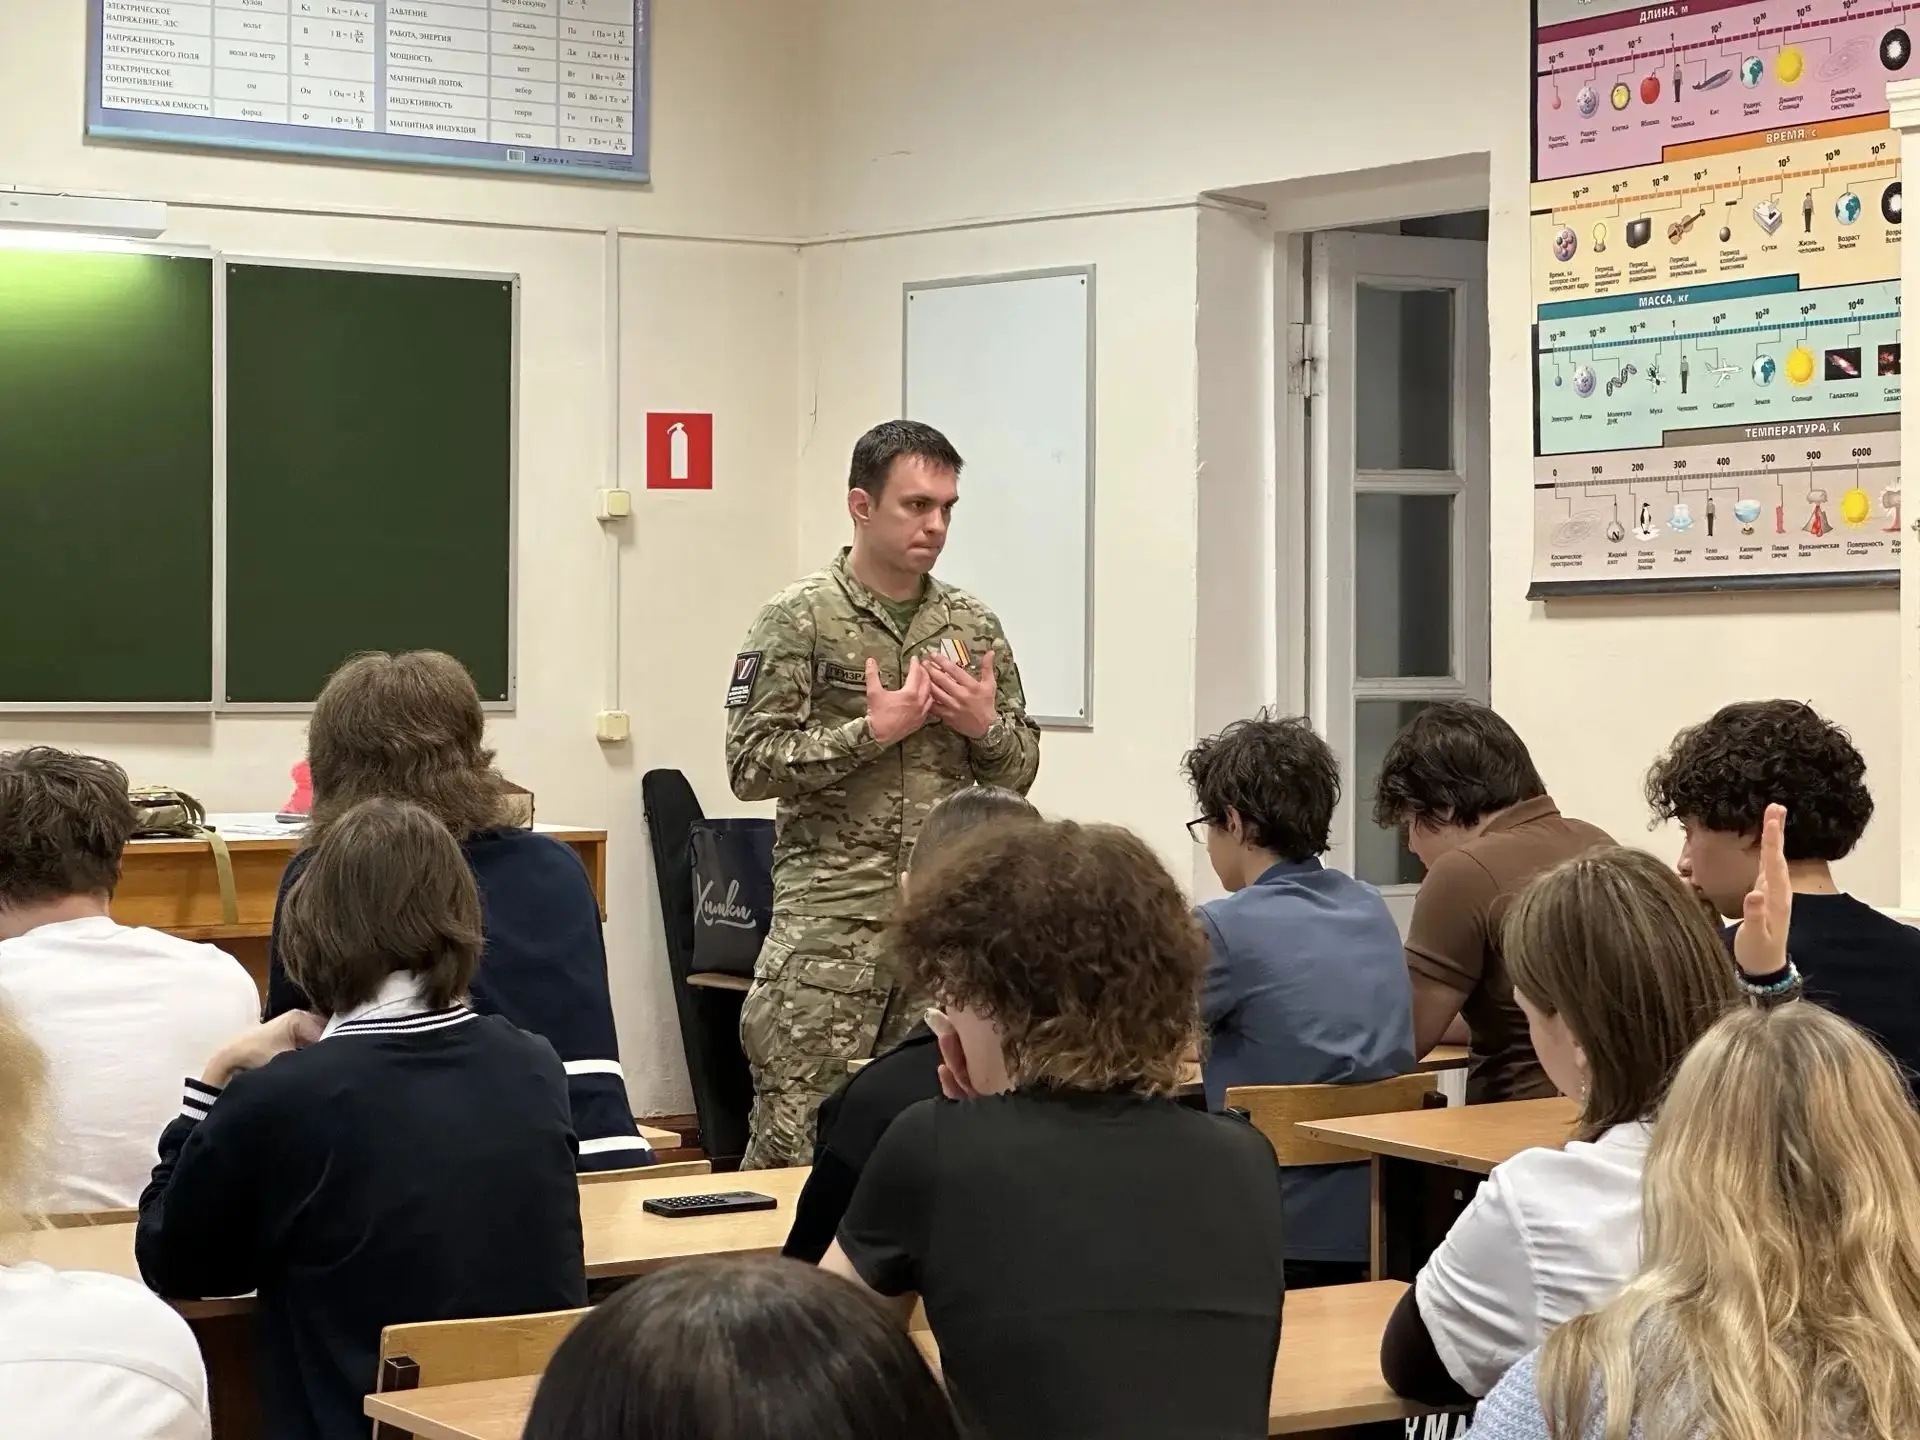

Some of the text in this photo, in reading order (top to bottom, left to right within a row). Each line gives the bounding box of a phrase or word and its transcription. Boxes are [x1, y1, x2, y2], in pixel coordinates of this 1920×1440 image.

[106, 2, 172, 15] ЭЛЕКТРИЧЕСКОЕ
[389, 8, 428, 18] ДАВЛЕНИЕ
[1640, 6, 1678, 23] ДЛИНА,
[106, 14, 162, 26] НАПРЯЖЕНИЕ,
[106, 33, 175, 46] НАПРЯЖЕННОСТЬ
[389, 29, 452, 42] РАБОТА, ЭНЕРГИЯ
[106, 45, 199, 60] ЭЛЕКТРИЧЕСКОГО ПОЛЯ
[390, 52, 432, 62] МОЩНОСТЬ
[106, 64, 172, 76] ЭЛЕКТРИЧЕСКОЕ
[105, 75, 173, 88] СОПРОТИВЛЕНИЕ
[390, 74, 463, 88] МАГНИТНЫЙ ПОТОК
[106, 95, 208, 110] ЭЛЕКТРИЧЕСКАЯ ЕМКОСТЬ
[390, 96, 452, 109] ИНДУКТИВНОСТЬ
[390, 120, 476, 134] МАГНИТНАЯ ИНДУКЦИЯ
[1737, 165, 1741, 174] 1
[1639, 294, 1675, 307] МАССА,
[1829, 391, 1858, 400] Галактика
[1745, 423, 1830, 438] ТЕМПЕРАТУРА,
[1591, 465, 1602, 474] 100
[1631, 463, 1644, 472] 200
[1673, 460, 1686, 468] 300
[1716, 457, 1730, 466] 400
[1761, 453, 1775, 462] 500
[1806, 450, 1821, 460] 900
[1852, 447, 1872, 457] 6000
[1847, 540, 1884, 548] Поверхность
[829, 666, 868, 681] ПРИЗР
